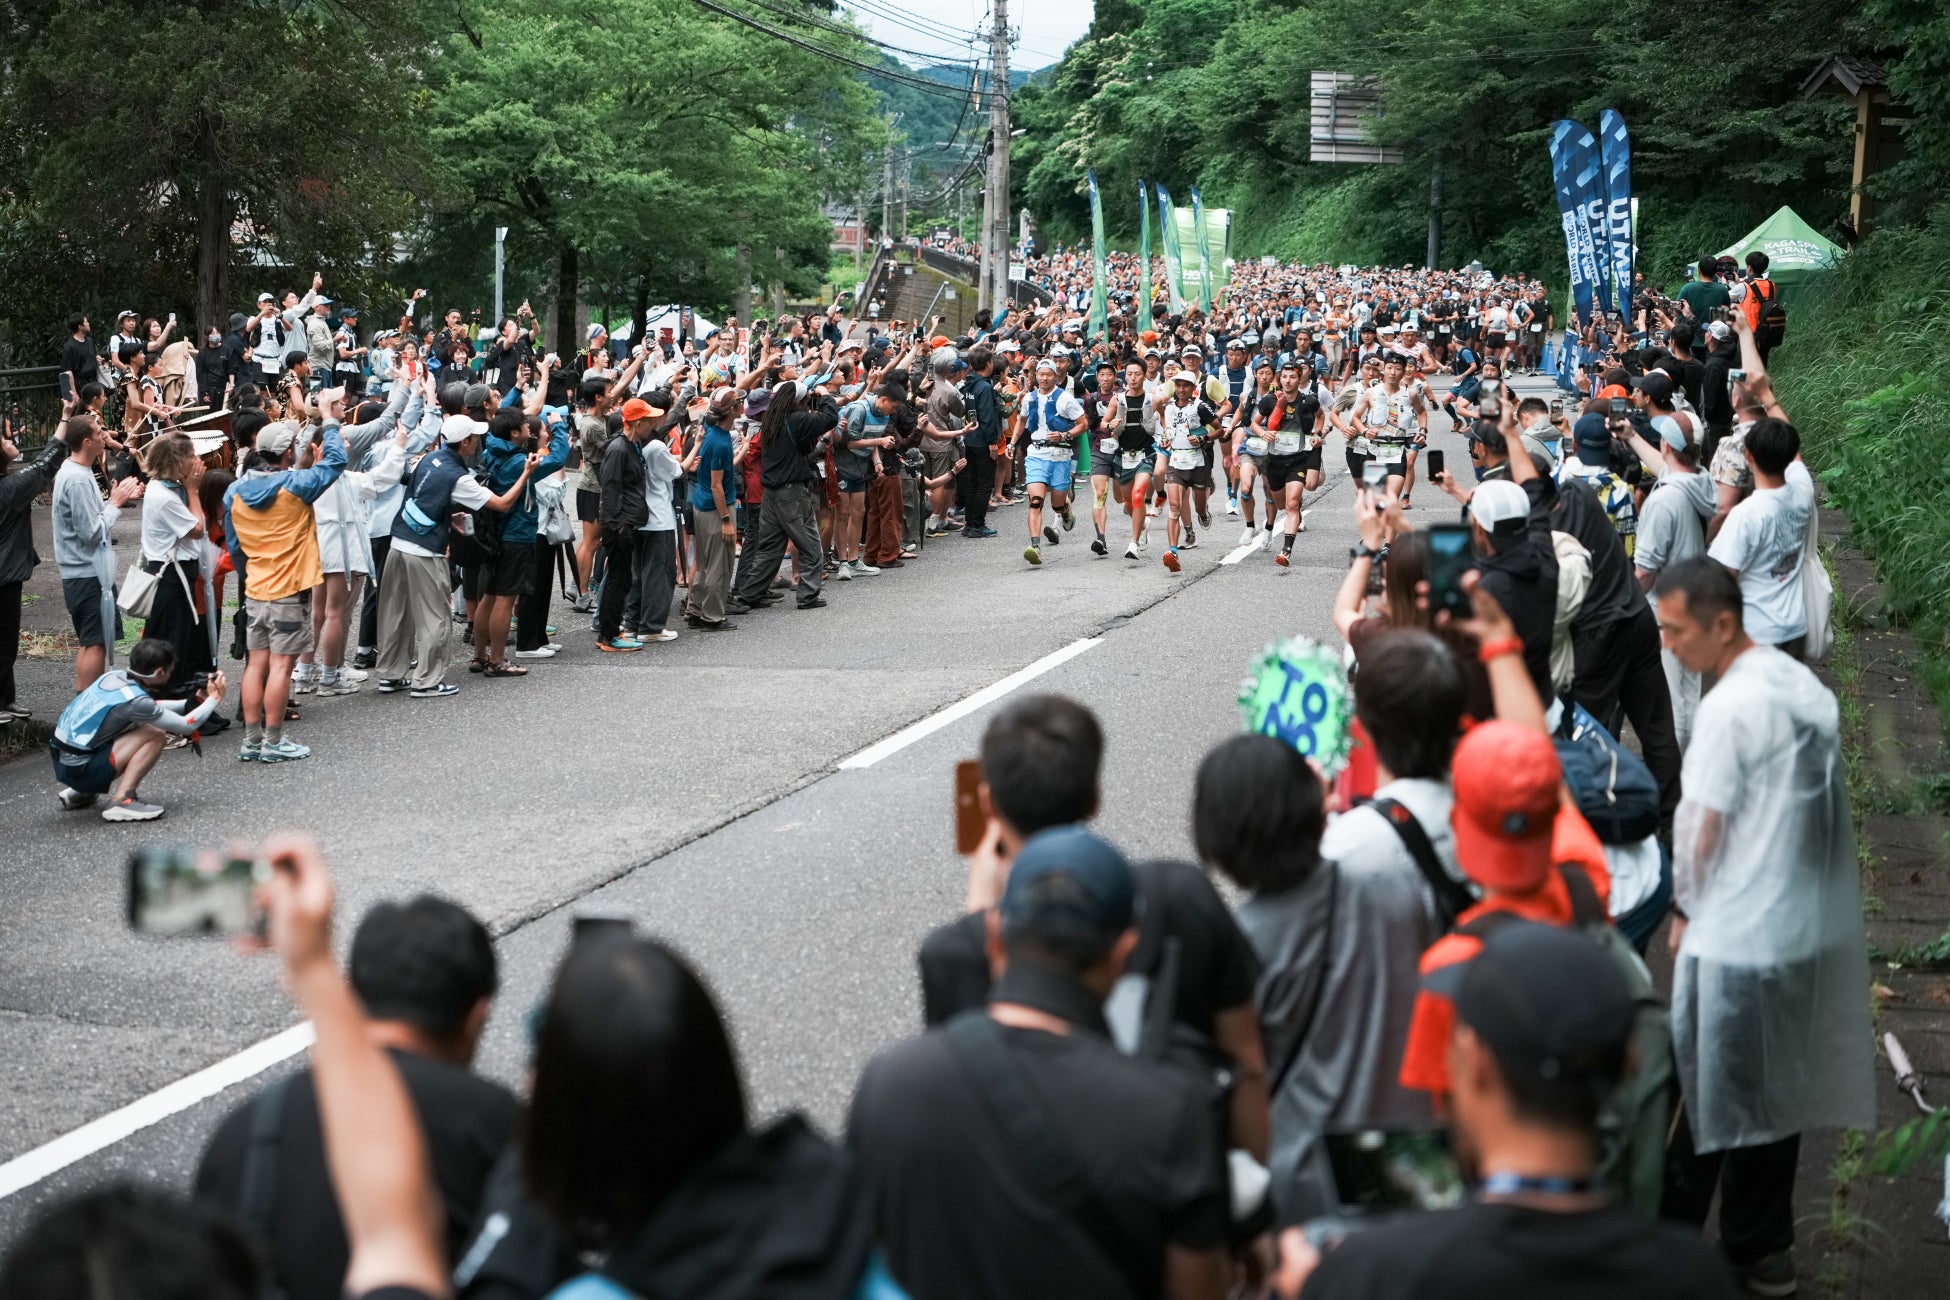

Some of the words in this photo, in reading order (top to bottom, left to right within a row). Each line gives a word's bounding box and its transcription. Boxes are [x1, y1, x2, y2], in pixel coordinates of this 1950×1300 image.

[1564, 213, 1577, 249] WORLD
[1577, 206, 1591, 247] WORLD
[1611, 197, 1631, 288] UTMB
[1570, 252, 1580, 282] SERIES
[1777, 246, 1809, 255] TRAIL
[1278, 659, 1328, 724] TO
